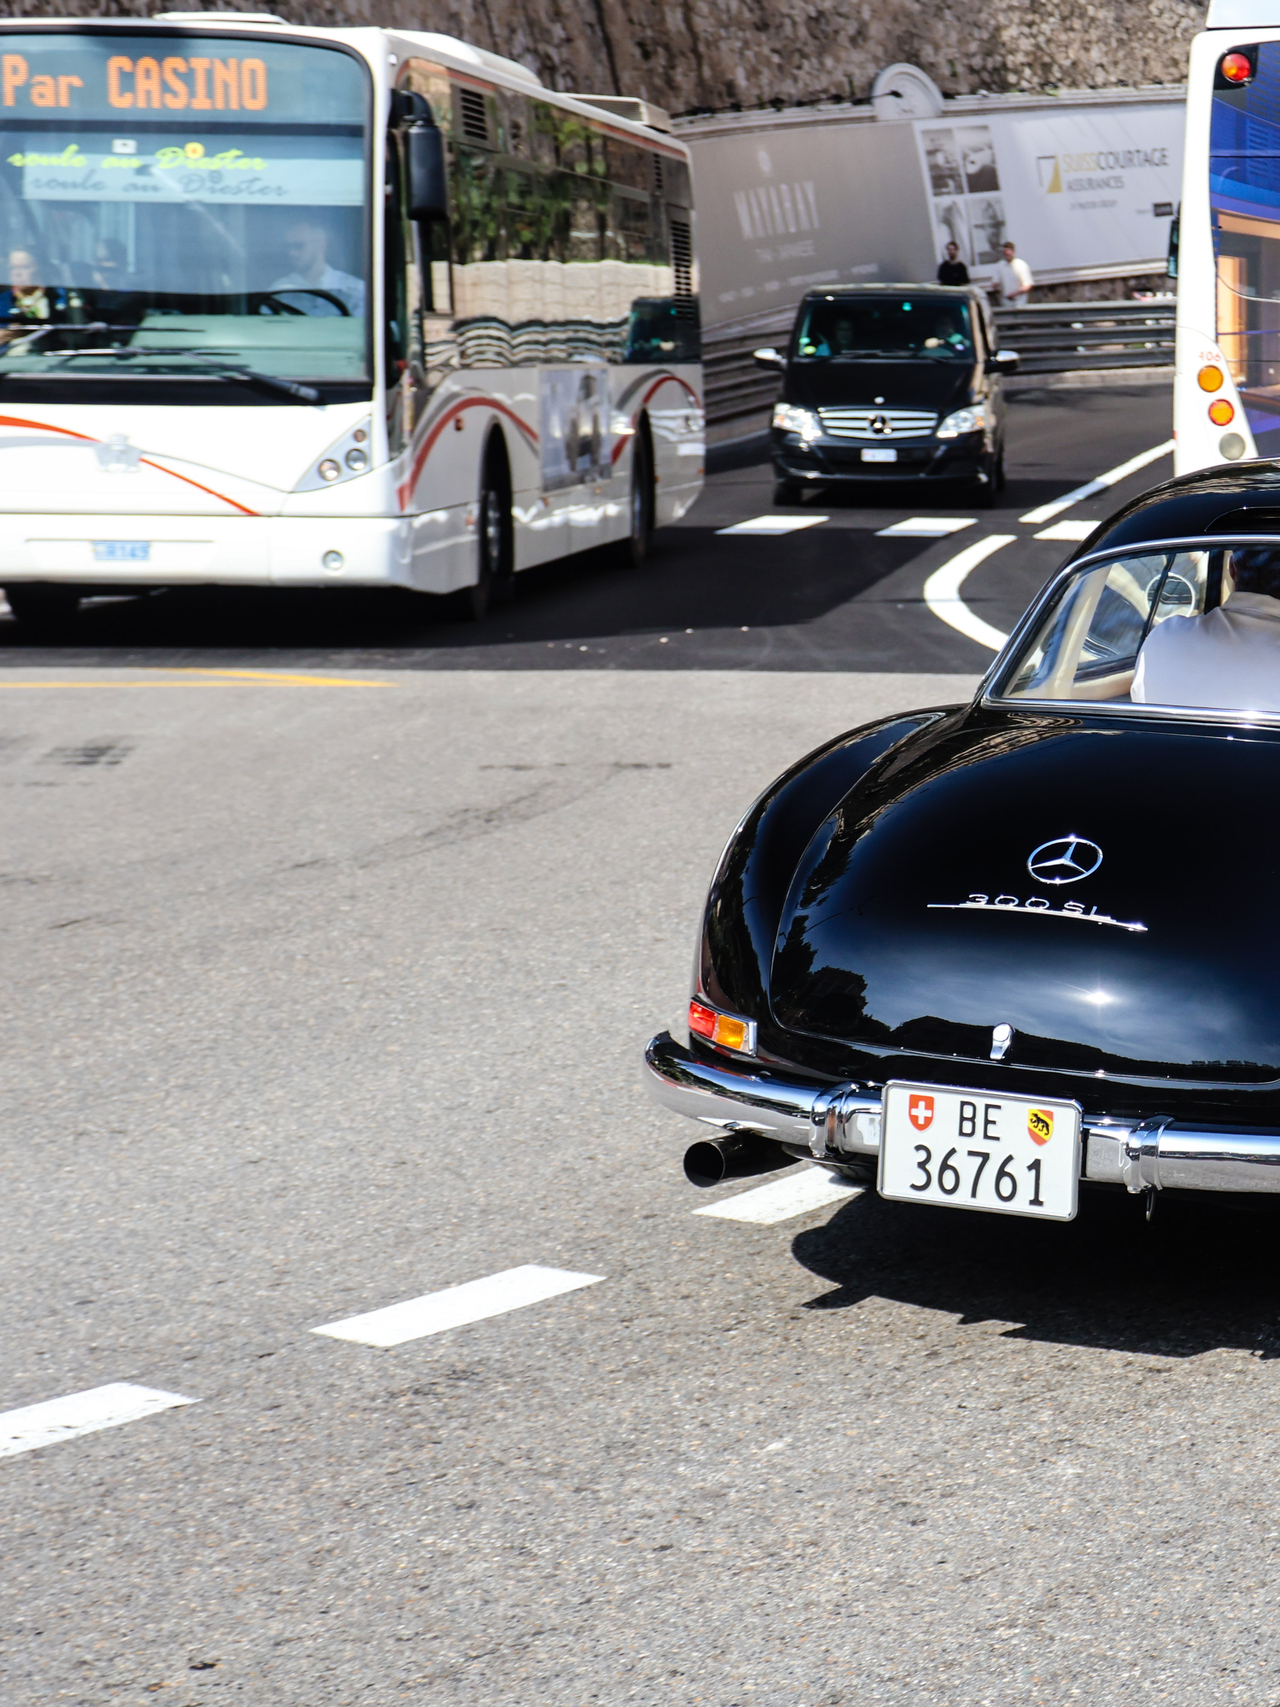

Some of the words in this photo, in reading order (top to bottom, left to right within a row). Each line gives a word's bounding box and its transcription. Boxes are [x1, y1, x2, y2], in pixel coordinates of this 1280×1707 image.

[2, 54, 84, 107] Par
[107, 56, 268, 111] CASINO
[966, 894, 1051, 911] 300
[958, 1100, 1002, 1141] BE
[909, 1143, 1044, 1207] 36761
